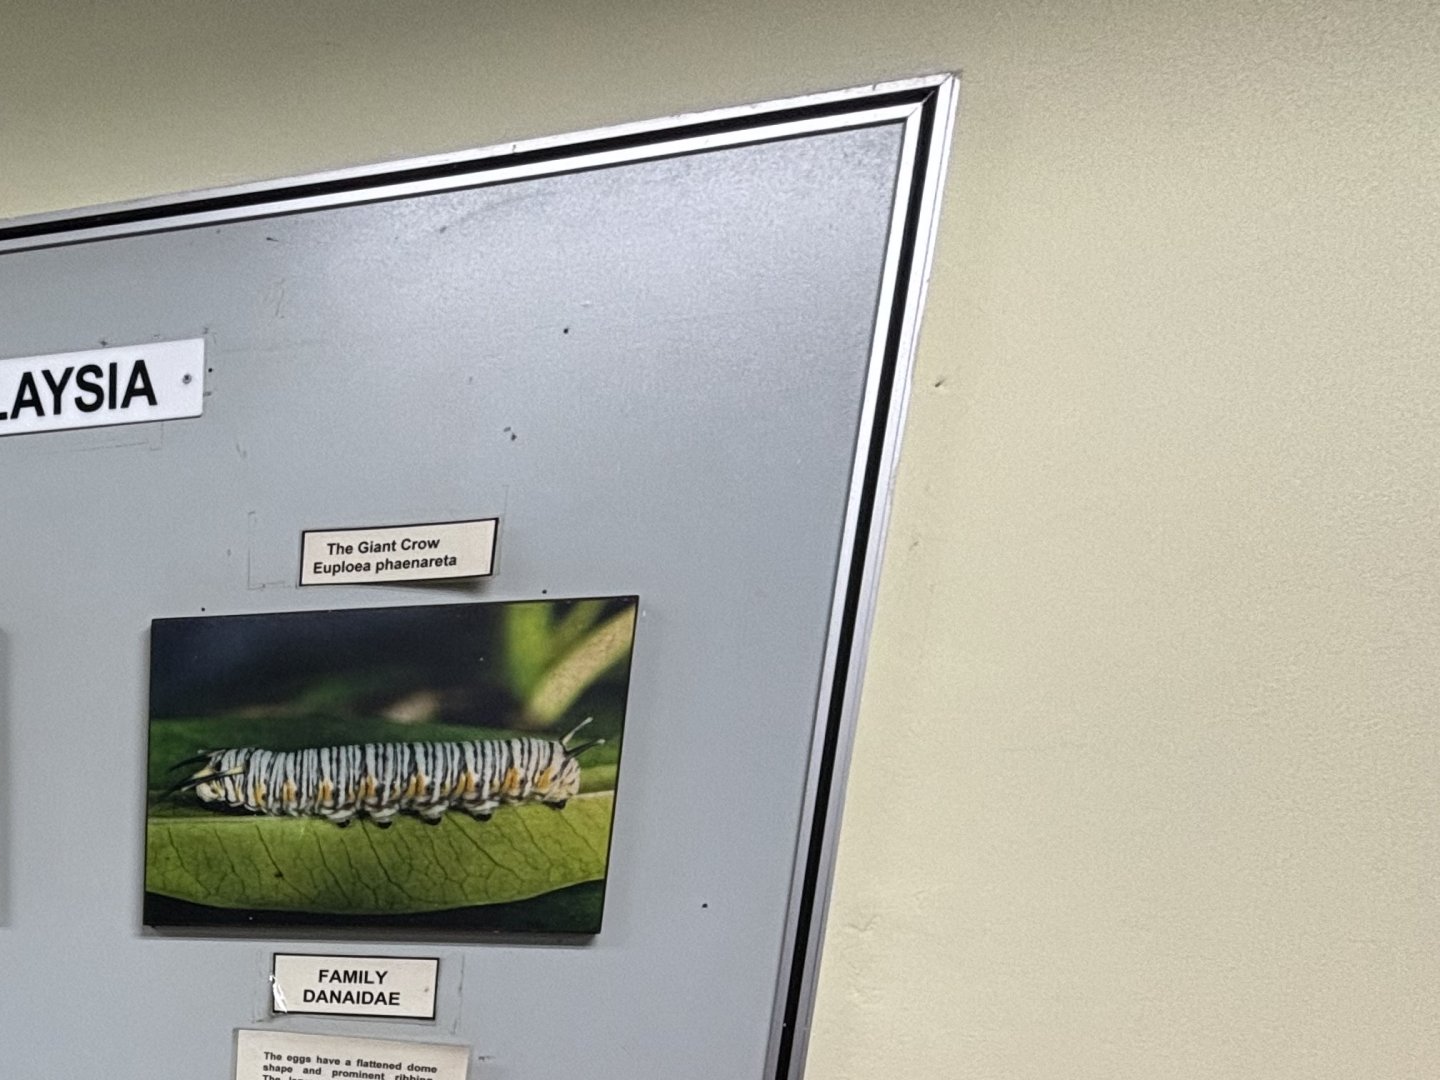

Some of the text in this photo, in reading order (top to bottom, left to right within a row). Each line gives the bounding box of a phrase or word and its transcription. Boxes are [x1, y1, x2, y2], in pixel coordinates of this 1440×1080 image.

[327, 538, 440, 555] The Giant Crow
[313, 555, 457, 576] Euploea phaenareta
[318, 969, 388, 985] FAMILY
[303, 989, 401, 1006] DANAIDAE
[263, 1051, 282, 1060] The
[286, 1055, 311, 1064] eggs
[316, 1055, 340, 1065] have
[356, 1058, 402, 1070] flattened
[406, 1063, 437, 1073] dome
[262, 1063, 292, 1074] shape
[302, 1066, 321, 1075] and
[331, 1070, 384, 1080] prominent
